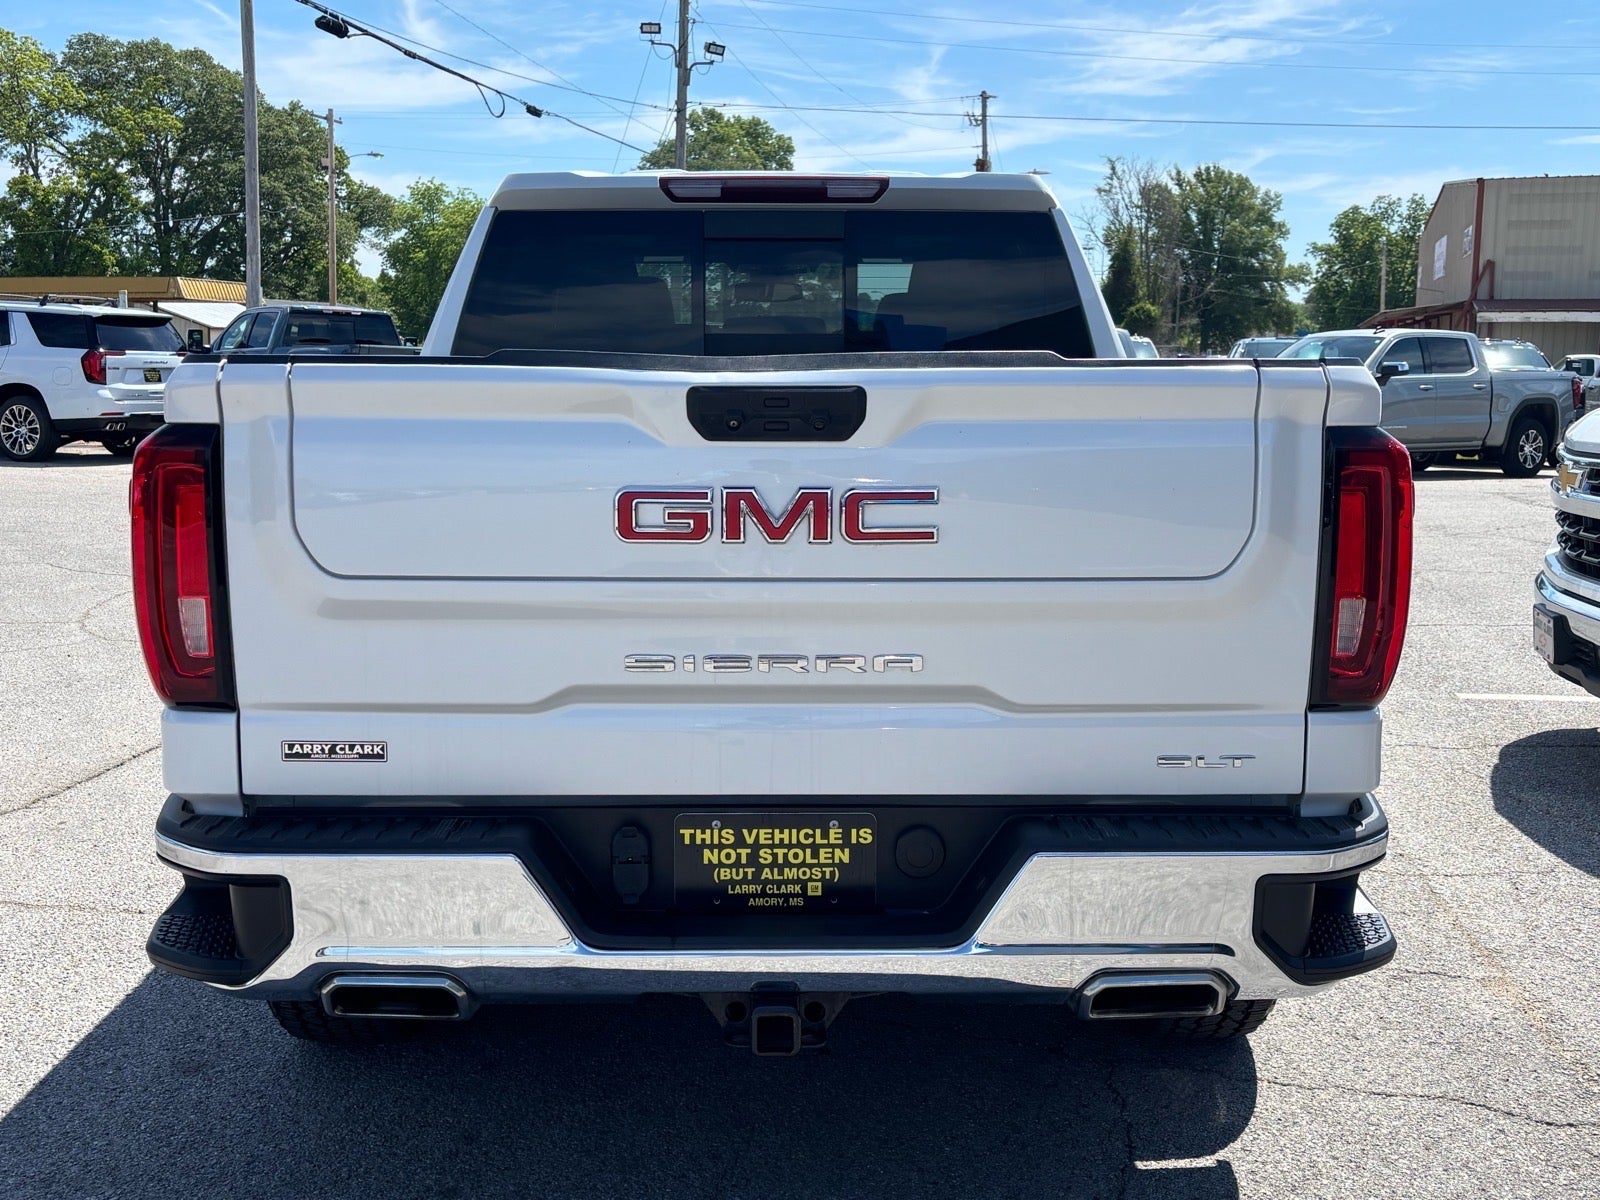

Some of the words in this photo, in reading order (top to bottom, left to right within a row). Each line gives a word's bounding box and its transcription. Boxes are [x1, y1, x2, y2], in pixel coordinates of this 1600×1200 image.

[614, 486, 939, 544] GMC
[624, 654, 924, 673] SIERRA
[284, 744, 331, 754] LARRY
[335, 744, 384, 755] CLARK
[1157, 754, 1256, 768] SLT
[679, 828, 735, 844] THIS
[742, 828, 843, 844] VEHICLE
[851, 828, 873, 844] IS
[703, 848, 751, 864] NOT
[758, 847, 850, 864] STOLEN
[713, 867, 755, 883] (BUT
[760, 867, 839, 882] ALMOST)
[728, 884, 762, 894] LARRY
[766, 884, 802, 894] CLARK
[748, 897, 787, 907] AMORY,
[789, 897, 804, 906] MS
